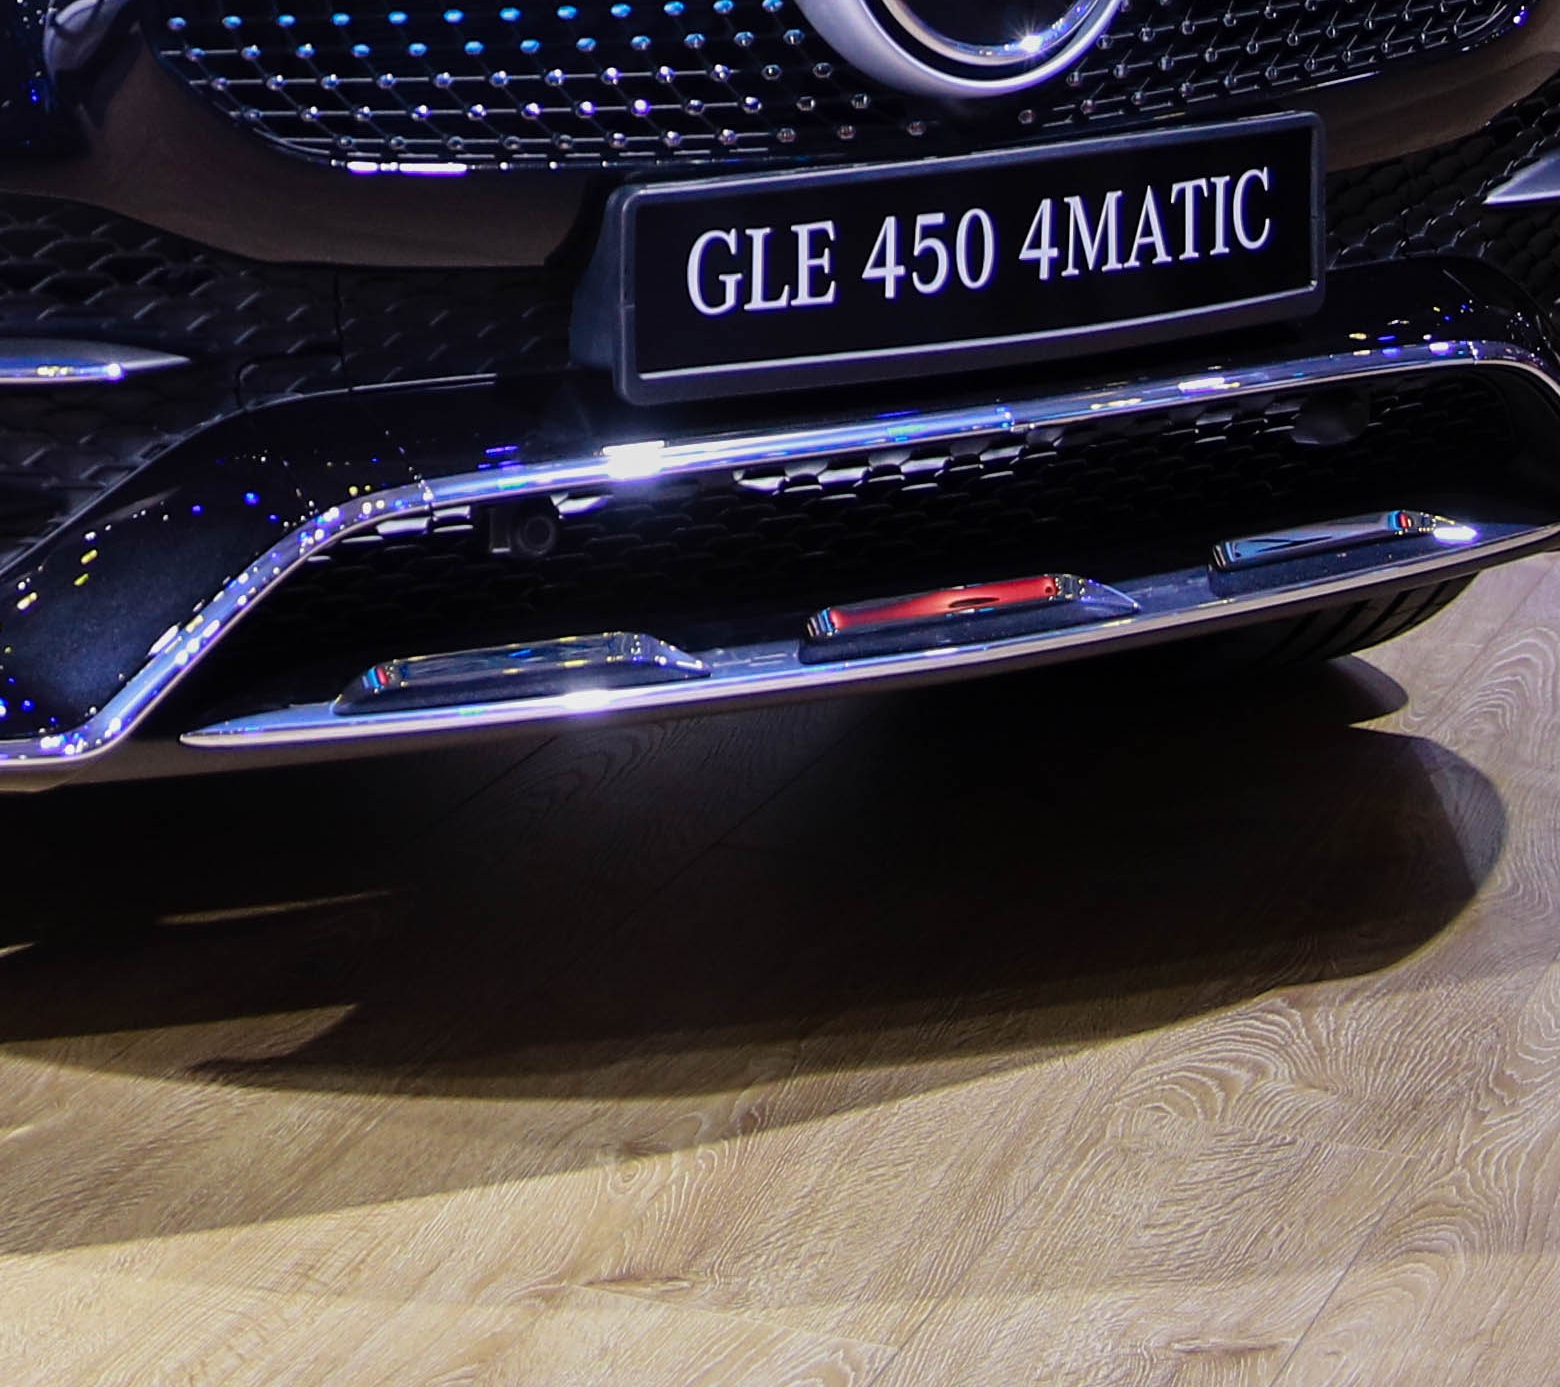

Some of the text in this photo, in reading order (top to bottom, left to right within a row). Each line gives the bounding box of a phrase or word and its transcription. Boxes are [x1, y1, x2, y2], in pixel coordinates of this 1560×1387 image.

[687, 166, 1271, 315] GLE 450 4MATIC
